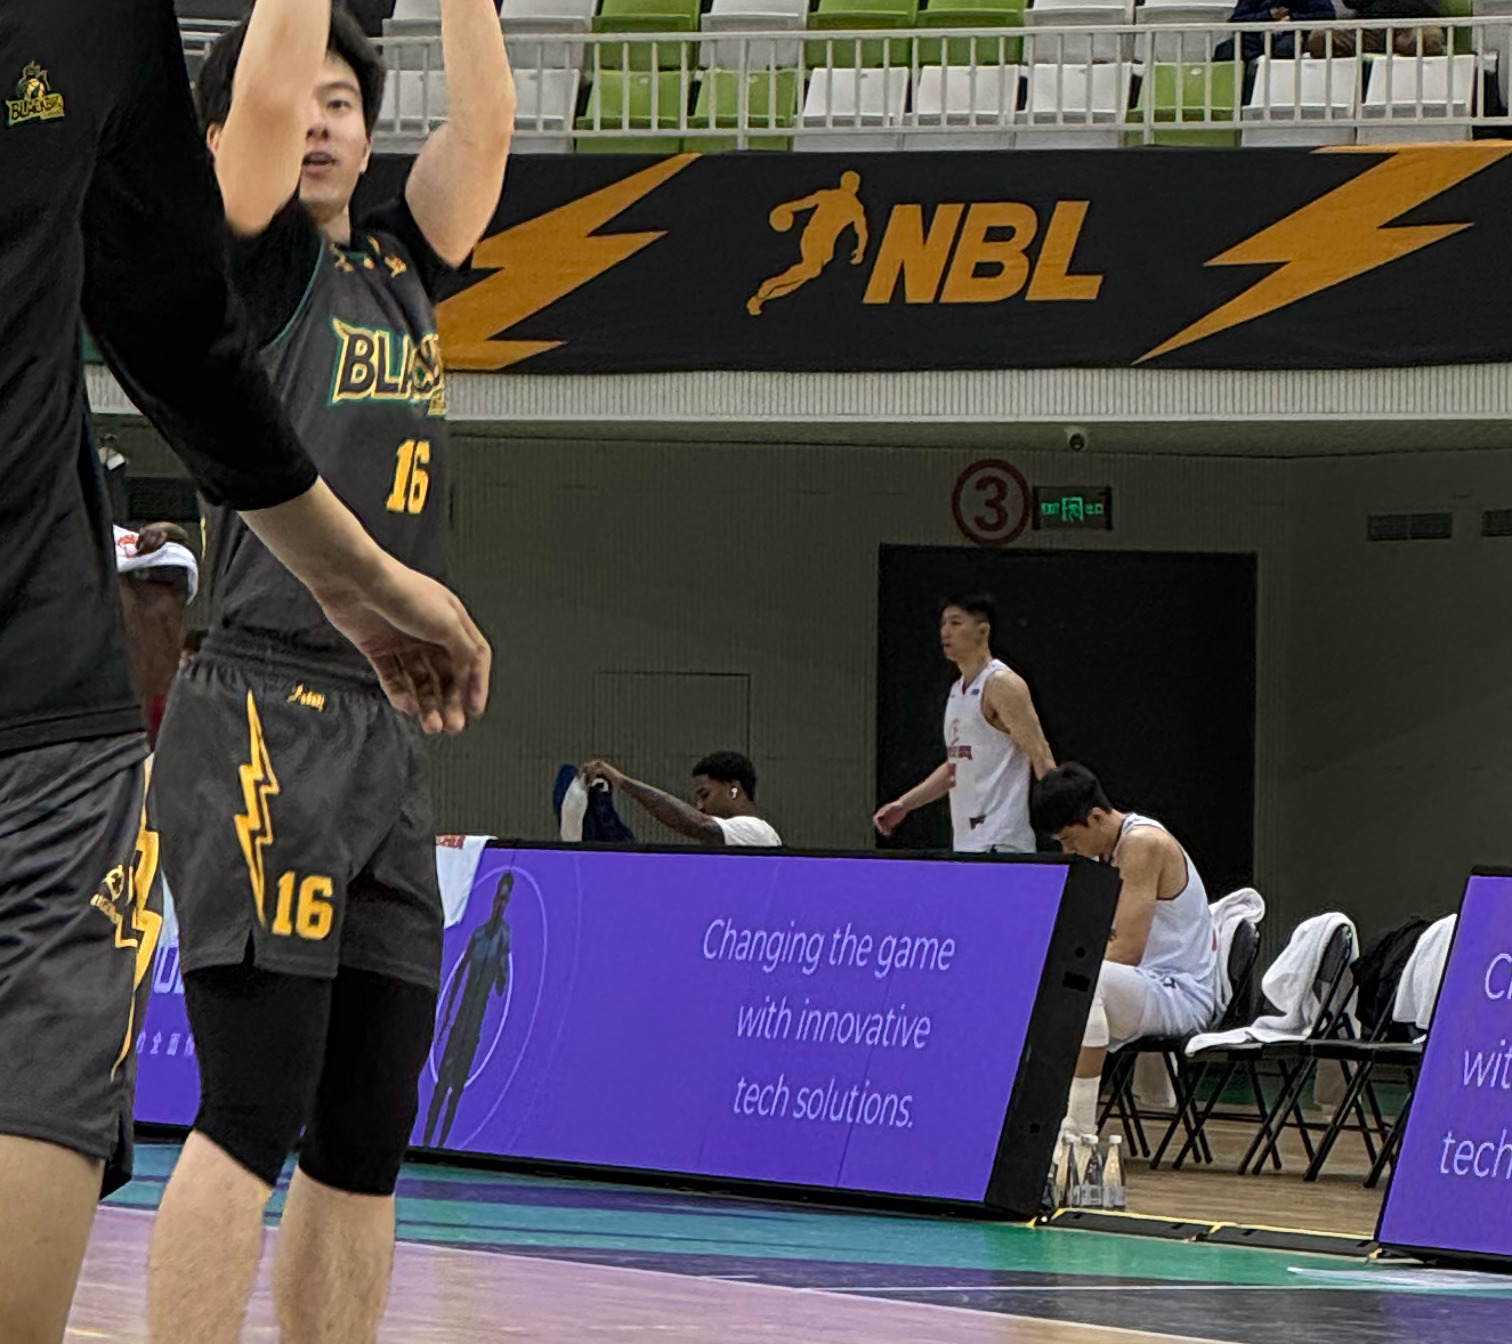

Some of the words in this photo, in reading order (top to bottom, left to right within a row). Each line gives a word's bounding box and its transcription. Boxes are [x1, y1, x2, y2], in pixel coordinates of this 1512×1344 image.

[862, 200, 1104, 304] NBL
[386, 439, 431, 514] 16
[973, 475, 1009, 532] 3
[272, 871, 334, 940] 16
[703, 917, 826, 976] Changing
[828, 922, 874, 967] the
[874, 935, 957, 979] game
[737, 995, 793, 1040] with
[795, 997, 932, 1049] innovative
[733, 1072, 791, 1117] tech
[792, 1077, 914, 1129] solutions.
[1439, 1128, 1512, 1180] tech
